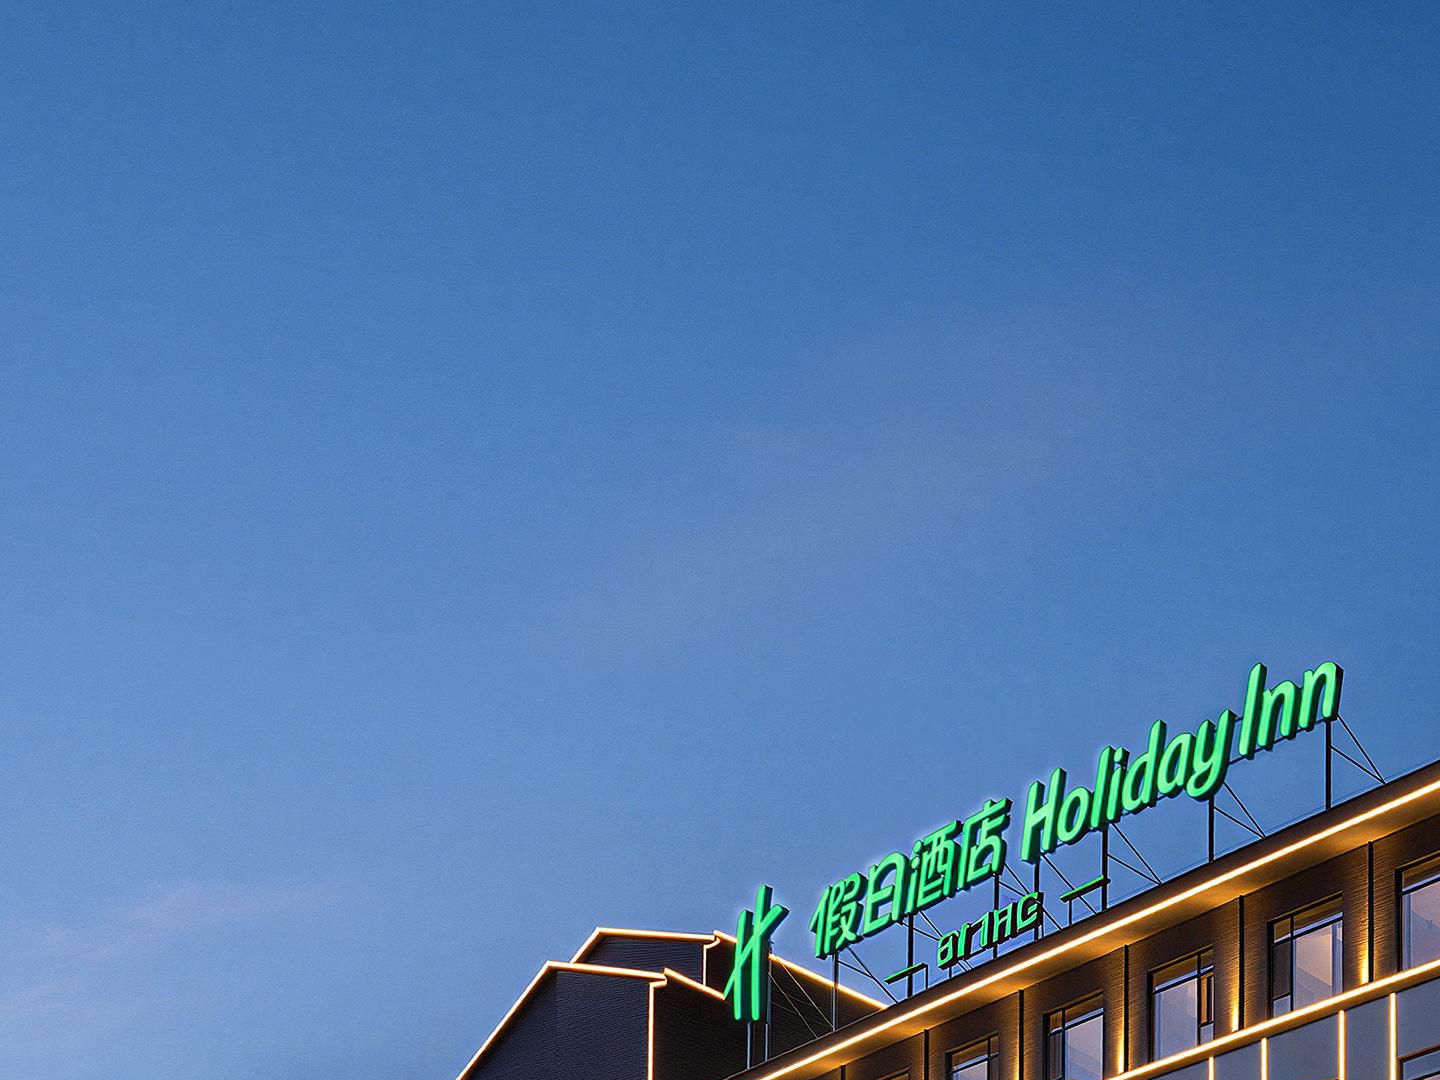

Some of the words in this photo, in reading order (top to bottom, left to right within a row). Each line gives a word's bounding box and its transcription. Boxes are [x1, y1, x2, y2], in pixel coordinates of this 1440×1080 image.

[808, 797, 1010, 958] 假日酒店
[1020, 707, 1232, 862] Holiday
[1237, 660, 1340, 756] Inn
